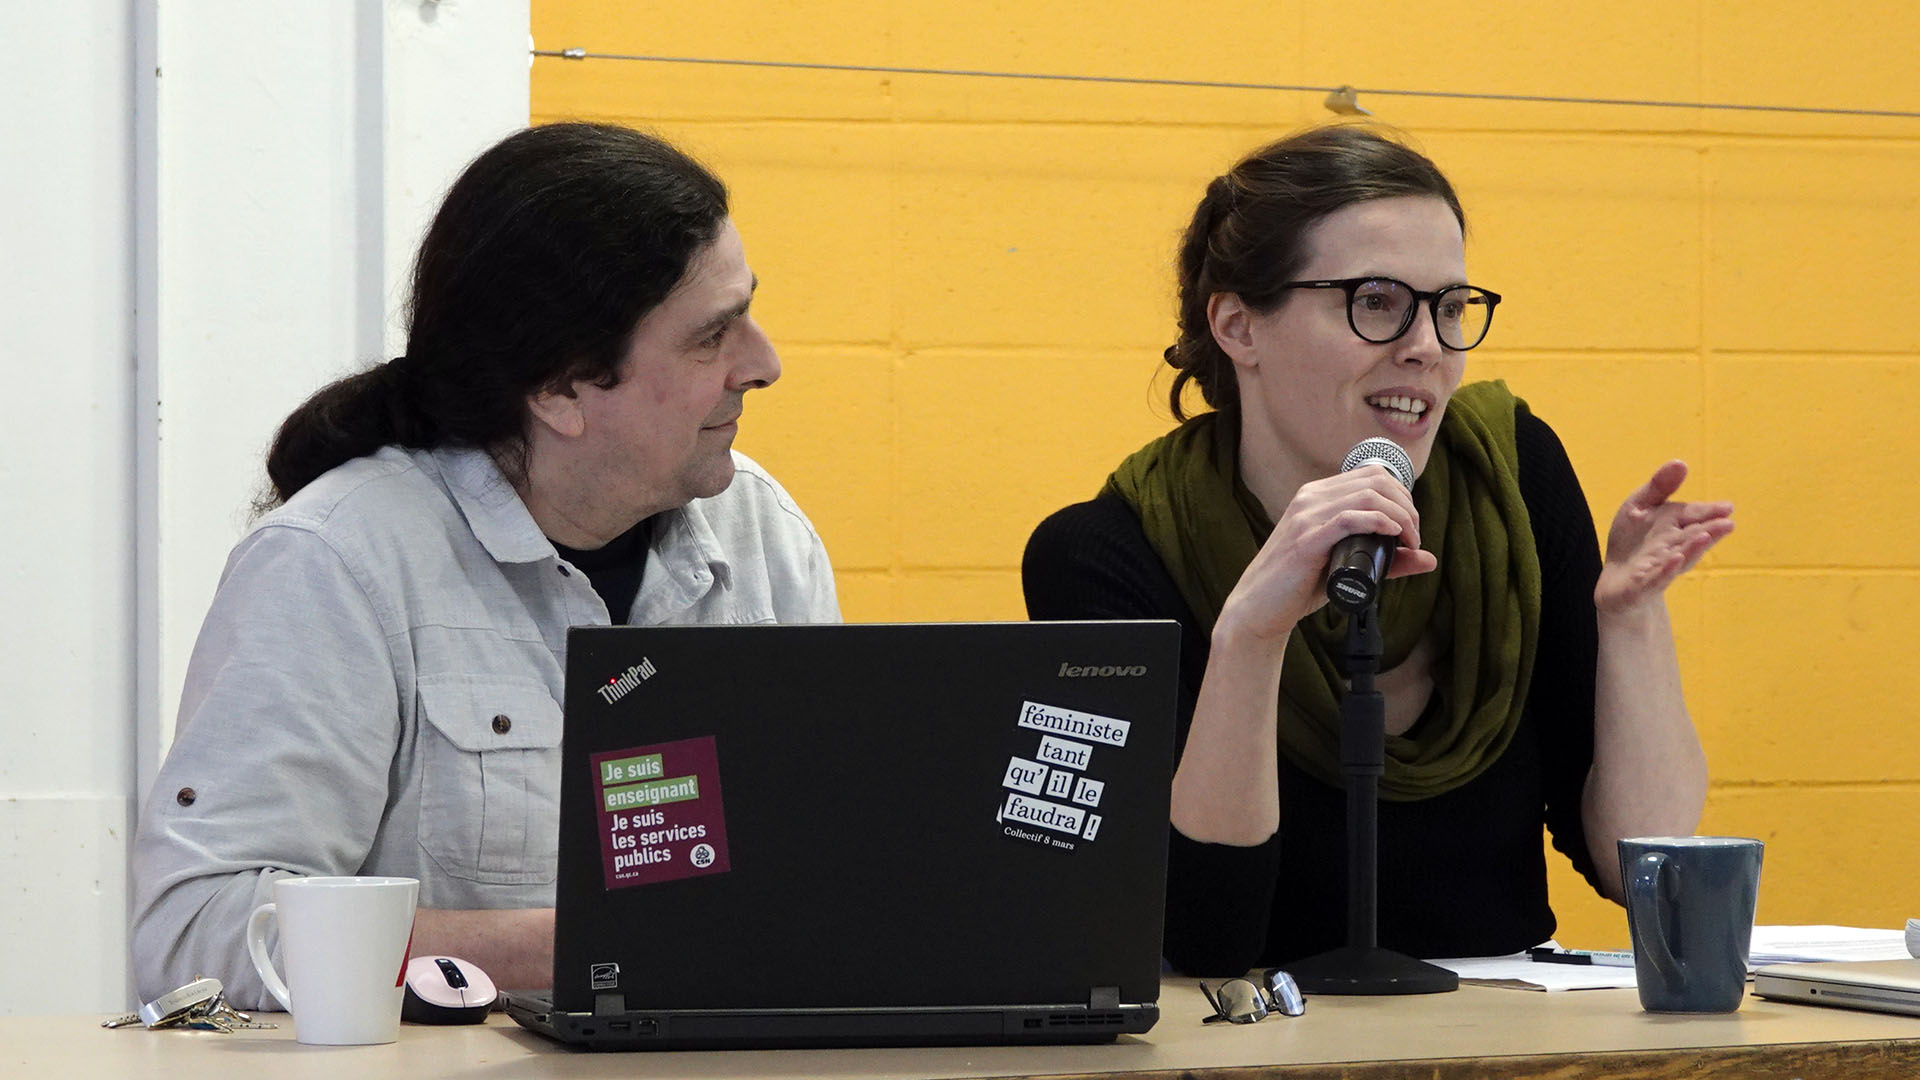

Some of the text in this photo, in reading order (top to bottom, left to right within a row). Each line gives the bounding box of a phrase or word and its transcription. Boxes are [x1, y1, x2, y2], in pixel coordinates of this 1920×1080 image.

[1336, 582, 1367, 599] SHURE
[597, 656, 657, 704] ThinkPad
[1058, 662, 1147, 677] lenovo
[1022, 705, 1124, 742] féministe
[1043, 742, 1086, 766] tant
[605, 758, 661, 781] Je suis
[607, 779, 696, 806] enseignant
[1050, 774, 1068, 794] il
[1077, 782, 1097, 802] le
[611, 809, 664, 831] Je suis
[1008, 797, 1077, 830] faudra
[612, 824, 706, 849] les services
[1004, 826, 1075, 850] Collectif 8 mars
[614, 847, 672, 872] publics
[696, 858, 711, 866] CSN
